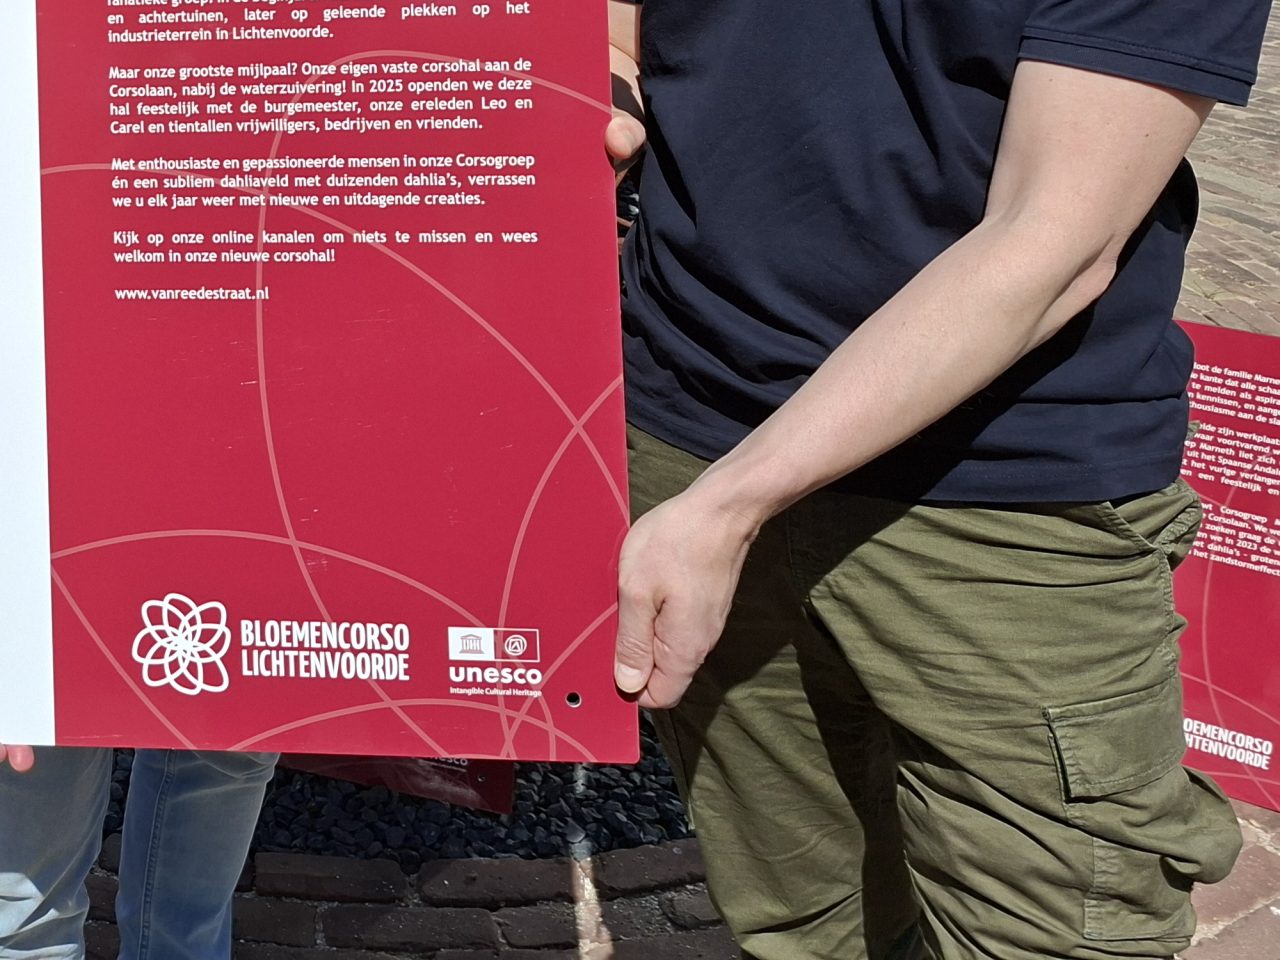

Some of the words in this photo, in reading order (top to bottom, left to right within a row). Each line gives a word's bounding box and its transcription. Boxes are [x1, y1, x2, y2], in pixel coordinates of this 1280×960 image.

[107, 14, 124, 24] en
[138, 9, 228, 23] achtertuinen,
[244, 8, 276, 20] later
[291, 9, 308, 22] op
[323, 4, 386, 21] geleende
[401, 3, 456, 19] plekken
[472, 4, 490, 17] op
[506, 0, 530, 14] het
[108, 28, 212, 42] industrieterrein
[215, 27, 228, 39] in
[232, 24, 333, 39] Lichtenvoorde.
[108, 66, 140, 79] Maar
[143, 68, 176, 78] onze
[179, 65, 234, 80] grootste
[237, 62, 297, 79] mijlpaal?
[301, 62, 336, 75] Onze
[340, 61, 377, 77] eigen
[381, 61, 418, 73] vaste
[422, 58, 480, 72] corsohal
[484, 61, 509, 71] aan
[514, 57, 532, 71] de
[109, 84, 177, 98] Corsolaan,
[182, 82, 215, 98] nabij
[219, 82, 236, 95] de
[240, 80, 346, 96] waterzuivering!
[351, 80, 364, 92] In
[369, 79, 403, 92] 2025
[408, 78, 468, 94] openden
[472, 80, 493, 90] we
[498, 77, 532, 90] deze
[110, 102, 130, 115] hal
[136, 101, 199, 117] feestelijk
[206, 102, 232, 113] met
[240, 100, 257, 113] de
[264, 100, 361, 115] burgemeester,
[369, 101, 403, 111] onze
[410, 96, 473, 110] ereleden
[481, 96, 507, 109] Leo
[514, 99, 532, 109] en
[110, 120, 144, 133] Carel
[148, 123, 164, 133] en
[168, 119, 232, 132] tientallen
[236, 118, 320, 134] vrijwilligers,
[324, 117, 390, 133] bedrijven
[394, 119, 412, 129] en
[416, 115, 482, 129] vrienden.
[111, 158, 135, 170] Met
[137, 156, 220, 170] enthousiaste
[222, 159, 239, 169] en
[242, 155, 344, 171] gepassioneerde
[348, 157, 400, 167] mensen
[403, 154, 416, 167] in
[419, 156, 453, 167] onze
[456, 153, 534, 169] Corsogroep
[111, 176, 128, 188] én
[133, 178, 158, 188] een
[163, 175, 214, 188] subliem
[220, 174, 288, 187] dahliaveld
[294, 175, 321, 186] met
[326, 173, 398, 186] duizenden
[404, 172, 461, 188] dahlia's,
[467, 175, 535, 185] verrassen
[112, 197, 132, 207] we
[135, 197, 144, 207] u
[147, 193, 168, 206] elk
[171, 194, 198, 209] jaar
[201, 196, 235, 206] weer
[239, 194, 266, 206] met
[269, 193, 318, 206] nieuwe
[322, 195, 340, 205] en
[344, 191, 420, 208] uitdagende
[424, 191, 485, 205] creaties.
[114, 249, 164, 262] welkom
[168, 249, 181, 262] in
[185, 252, 217, 262] onze
[221, 249, 270, 262] nieuwe
[273, 248, 335, 262] corsohal!
[114, 286, 269, 299] www.vanreedestraat.nl
[241, 620, 410, 649] BLOEMENCORSO
[242, 649, 410, 681] LICHTENVOORDE
[449, 666, 543, 685] unesco
[1183, 718, 1273, 755] OEMENCORSO
[1184, 732, 1271, 770] HTENVOORDE
